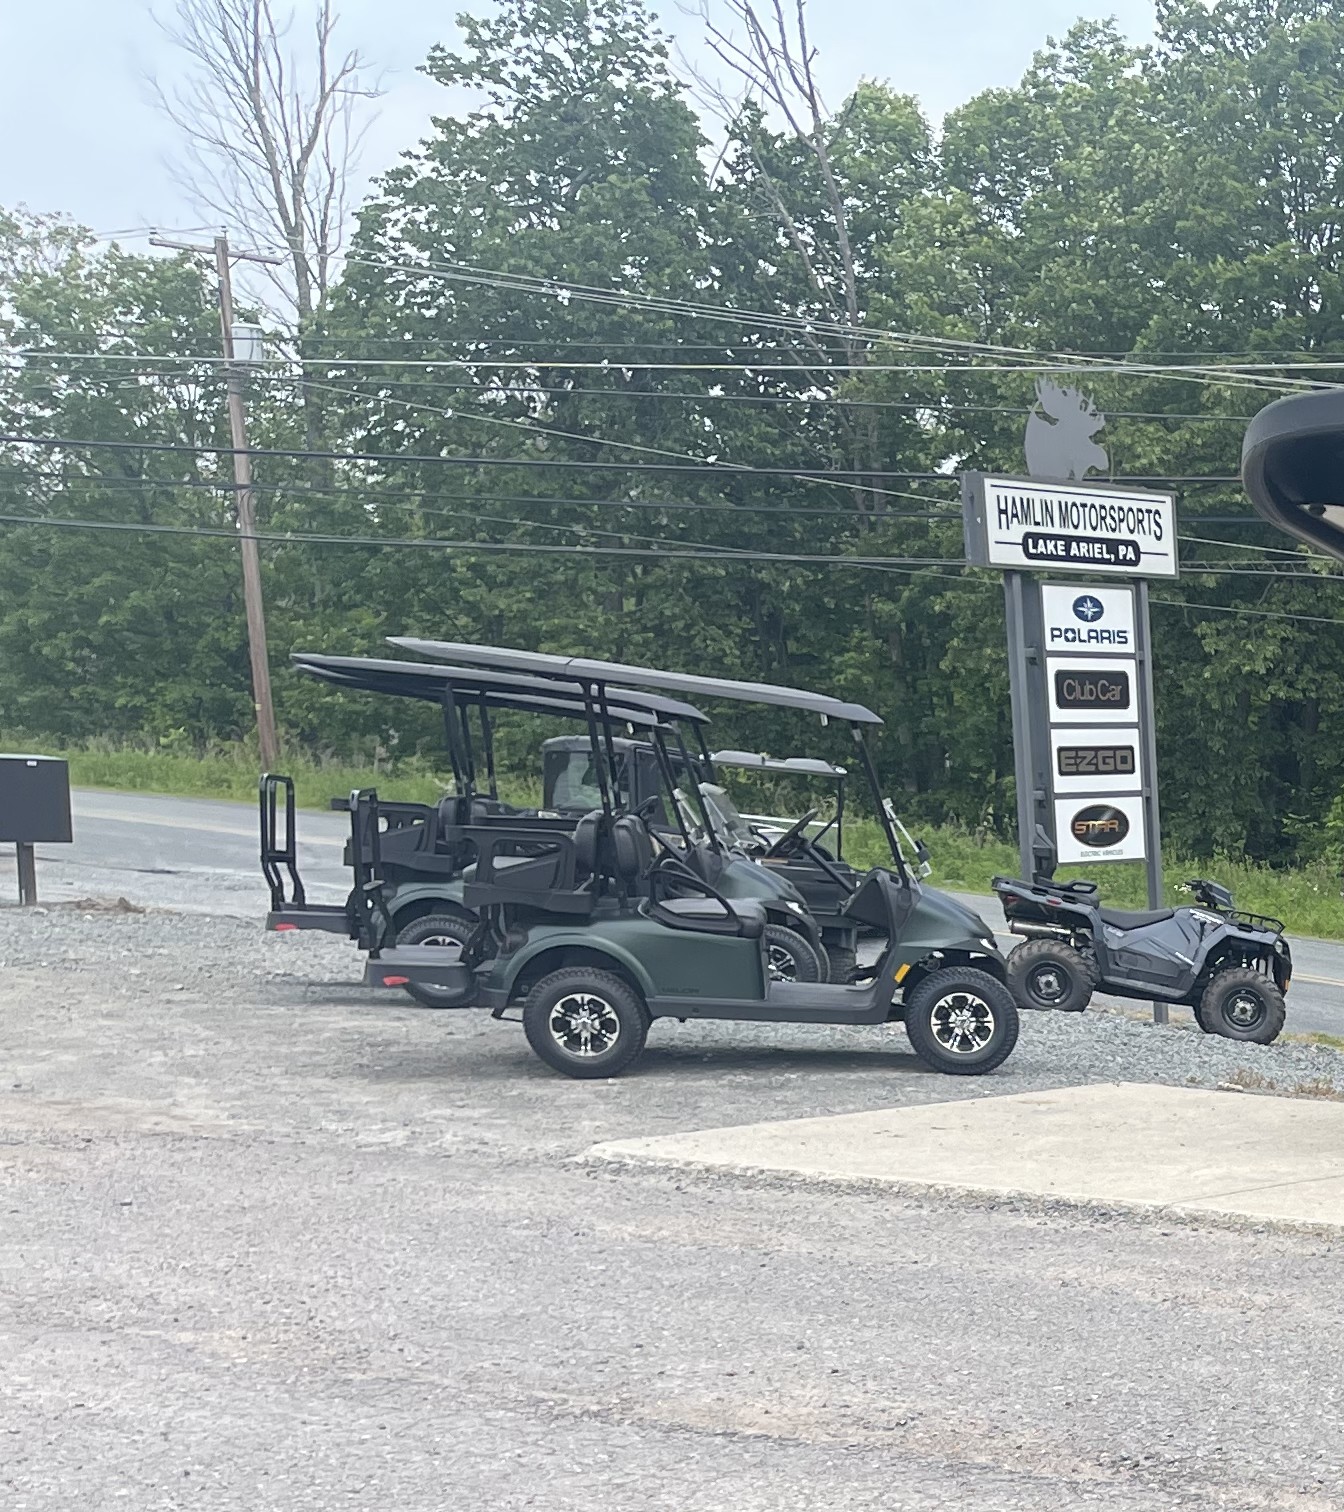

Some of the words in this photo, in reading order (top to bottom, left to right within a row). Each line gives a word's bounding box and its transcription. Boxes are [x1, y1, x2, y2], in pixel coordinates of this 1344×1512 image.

[996, 494, 1055, 530] HAMLIN
[1058, 500, 1163, 541] MOTORSPORTS
[1027, 538, 1066, 556] LAKE
[1070, 541, 1115, 562] ARIEL,
[1118, 545, 1136, 561] PA
[1050, 627, 1129, 644] POLARIS
[1063, 679, 1097, 700] Club
[1098, 679, 1122, 700] Car
[1074, 820, 1119, 834] STAR
